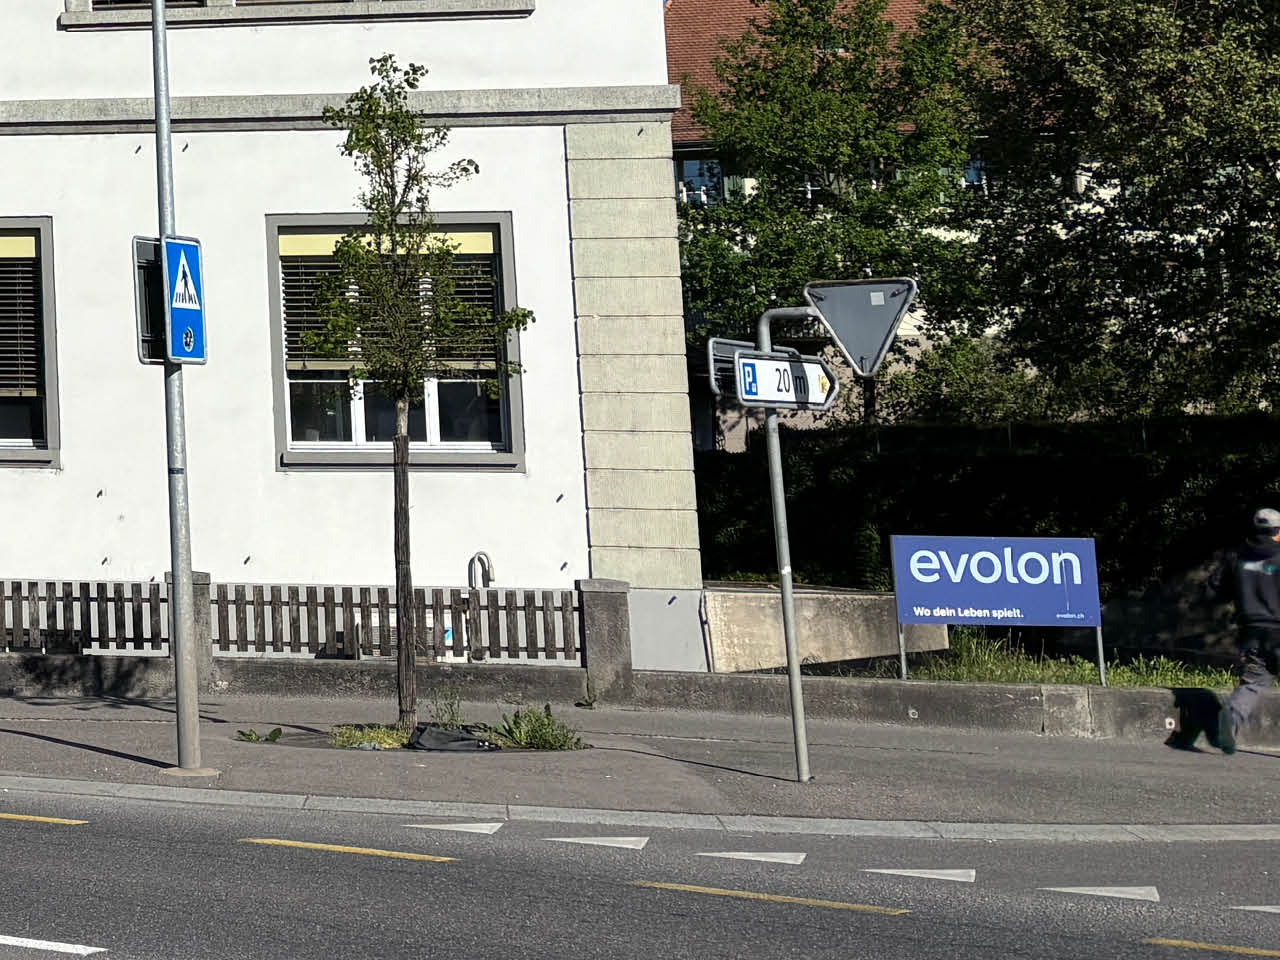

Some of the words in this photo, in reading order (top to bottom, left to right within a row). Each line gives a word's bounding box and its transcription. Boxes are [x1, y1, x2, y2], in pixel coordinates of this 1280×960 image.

[744, 366, 753, 391] P
[775, 368, 790, 393] 20
[795, 375, 806, 394] m
[909, 547, 1082, 585] evolon
[913, 607, 931, 617] Wo
[933, 607, 956, 617] dein
[957, 607, 990, 617] Leben
[991, 608, 1025, 619] spielt.
